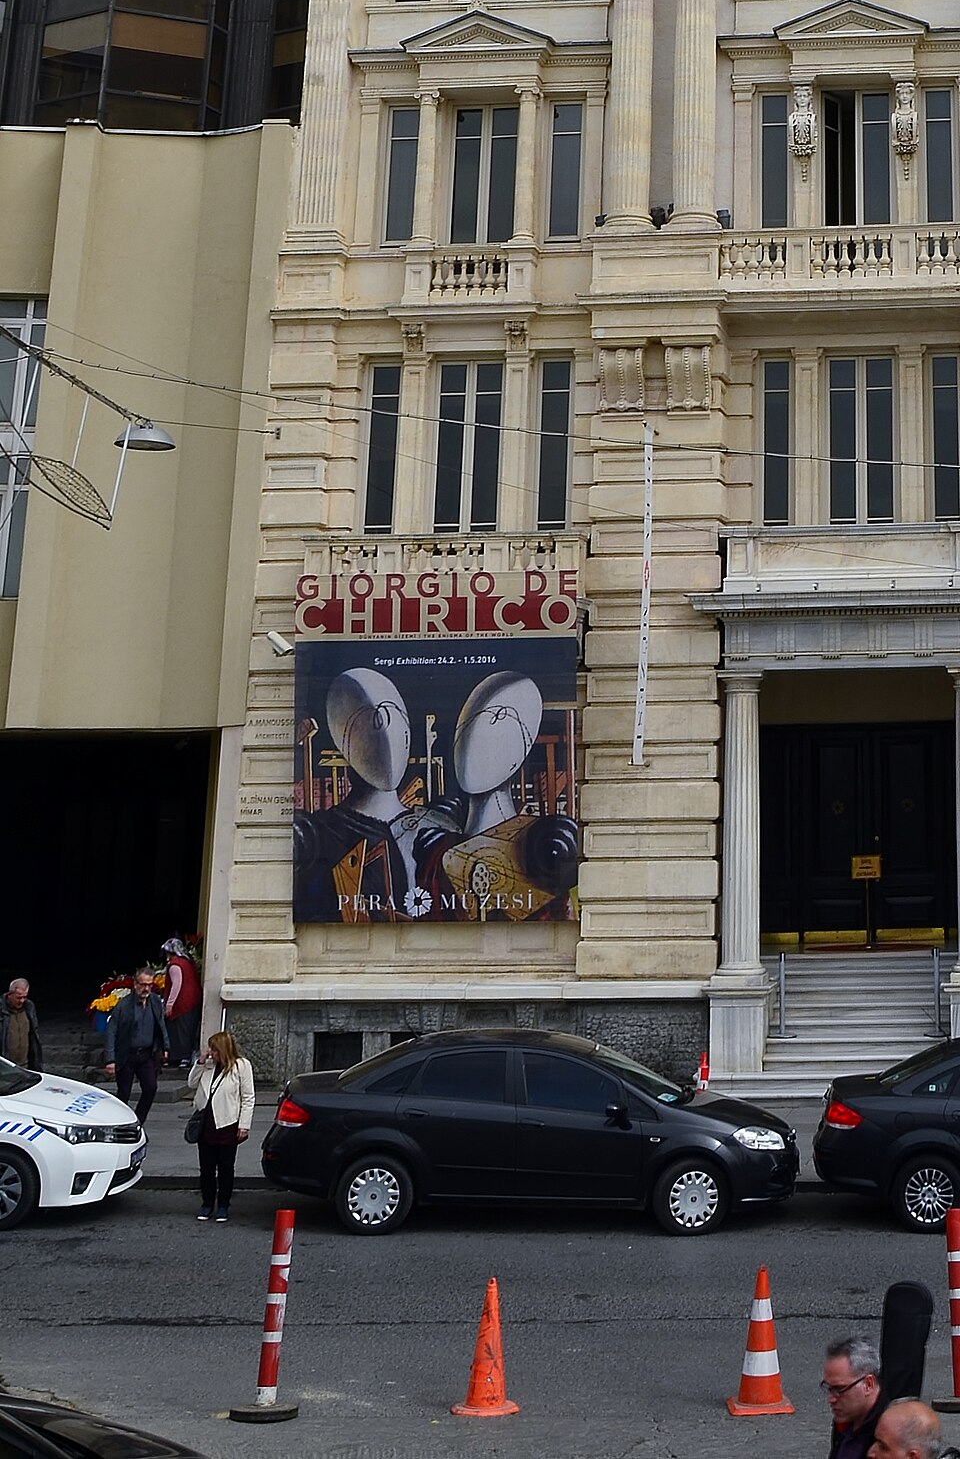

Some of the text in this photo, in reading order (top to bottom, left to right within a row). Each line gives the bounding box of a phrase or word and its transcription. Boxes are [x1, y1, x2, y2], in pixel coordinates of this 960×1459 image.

[296, 570, 577, 600] GIORGIO DE
[295, 594, 577, 636] CHIRICO
[374, 657, 395, 666] Sergi
[396, 656, 437, 665] Exhibition:
[437, 656, 457, 664] 24.2.
[464, 655, 497, 664] 1.5.2016
[338, 889, 533, 911] PERA MÜZESİ
